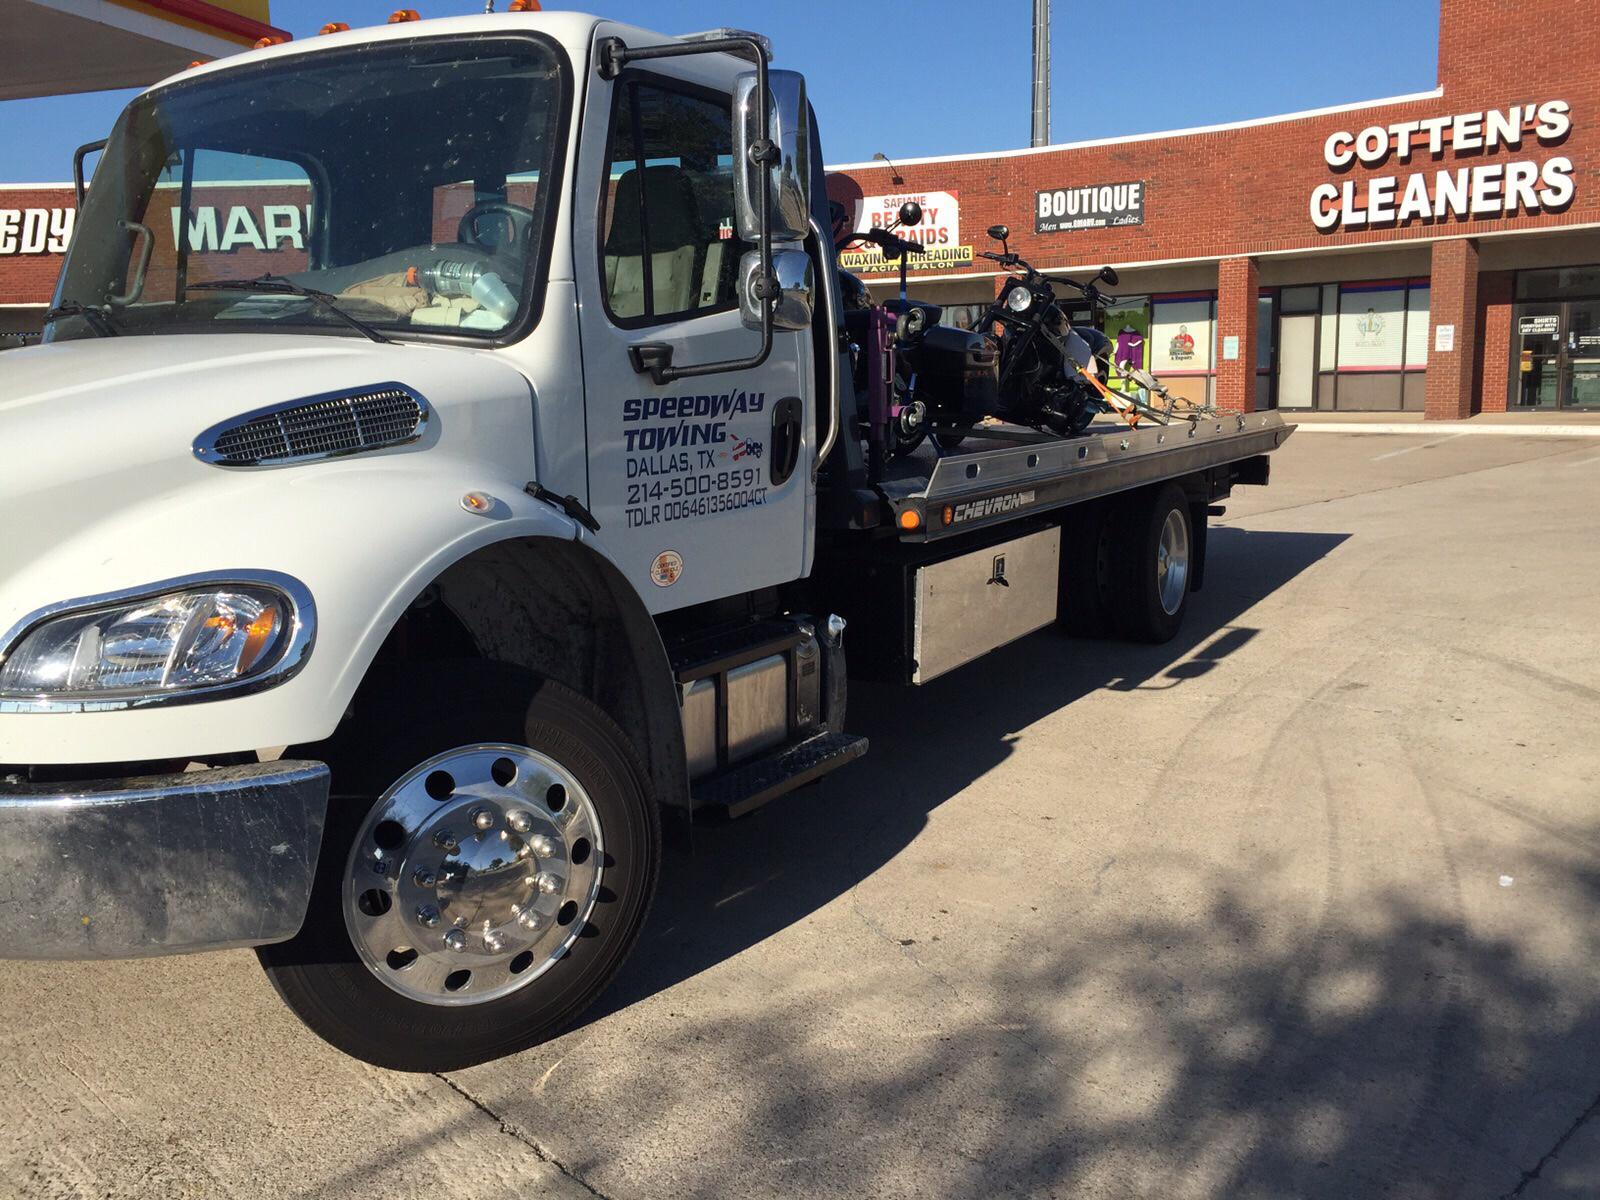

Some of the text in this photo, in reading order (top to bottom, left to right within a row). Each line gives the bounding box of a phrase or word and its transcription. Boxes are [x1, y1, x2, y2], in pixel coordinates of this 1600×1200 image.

[1324, 100, 1570, 166] COTTEN'S
[1039, 184, 1140, 218] BOUTIQUE
[1310, 156, 1575, 228] CLEANERS
[171, 204, 312, 250] MAR
[872, 208, 938, 228] BETY
[894, 227, 949, 246] RAIDS
[862, 261, 955, 273] FACIA SALON
[905, 247, 970, 262] HREADING
[623, 420, 727, 453] TOWING
[626, 450, 715, 478] DALLAS, TX
[628, 468, 761, 505] 214-500-8591
[625, 505, 661, 529] TDLR
[953, 492, 1021, 522] CHEVRON
